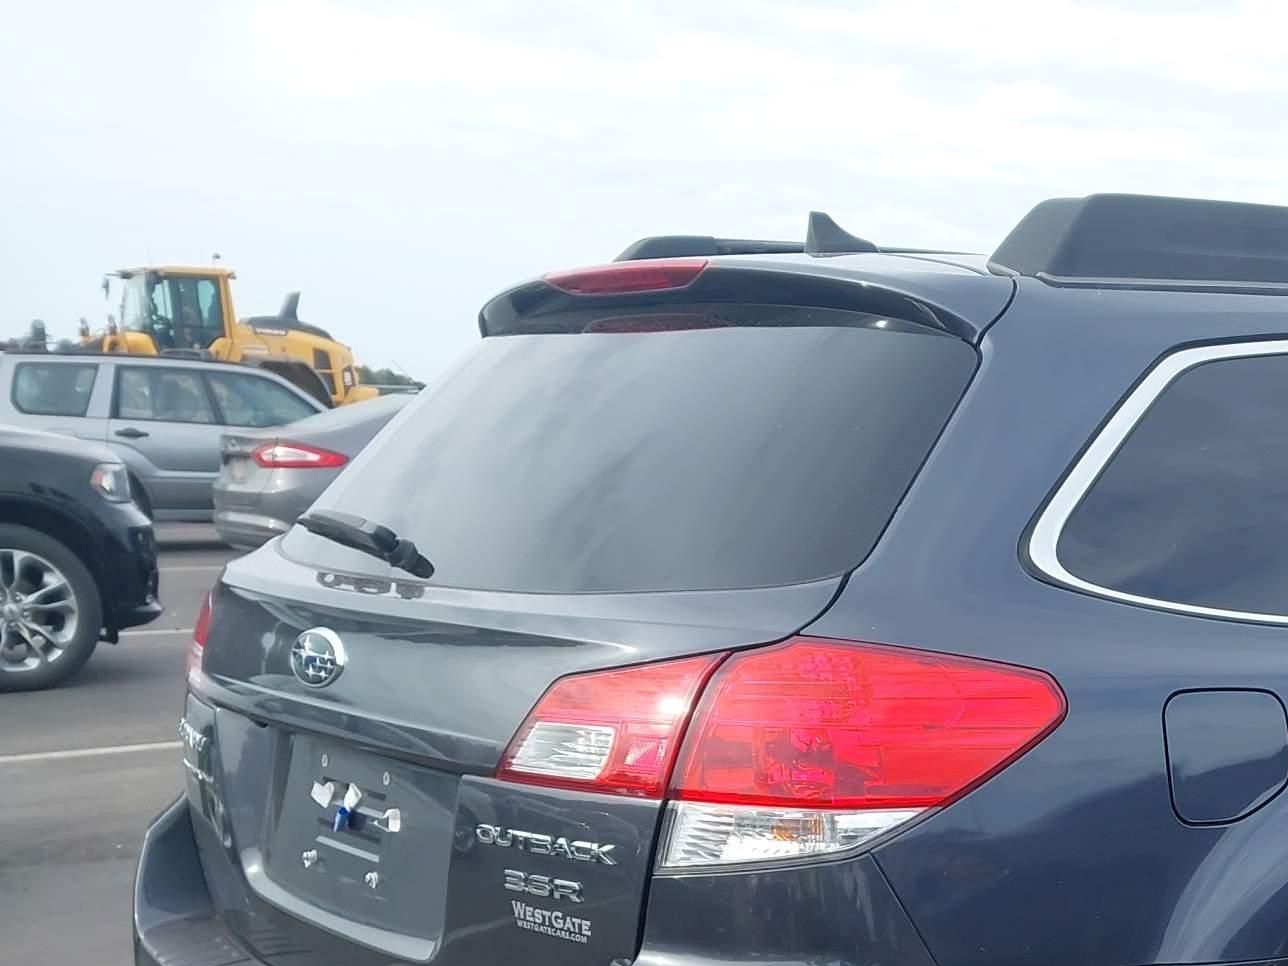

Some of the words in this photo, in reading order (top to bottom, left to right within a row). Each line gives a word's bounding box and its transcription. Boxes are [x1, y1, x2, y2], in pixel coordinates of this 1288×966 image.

[475, 823, 618, 866] OUTBACK
[503, 868, 585, 903] 3.6R
[516, 919, 588, 944] WESTGATECARS.COM
